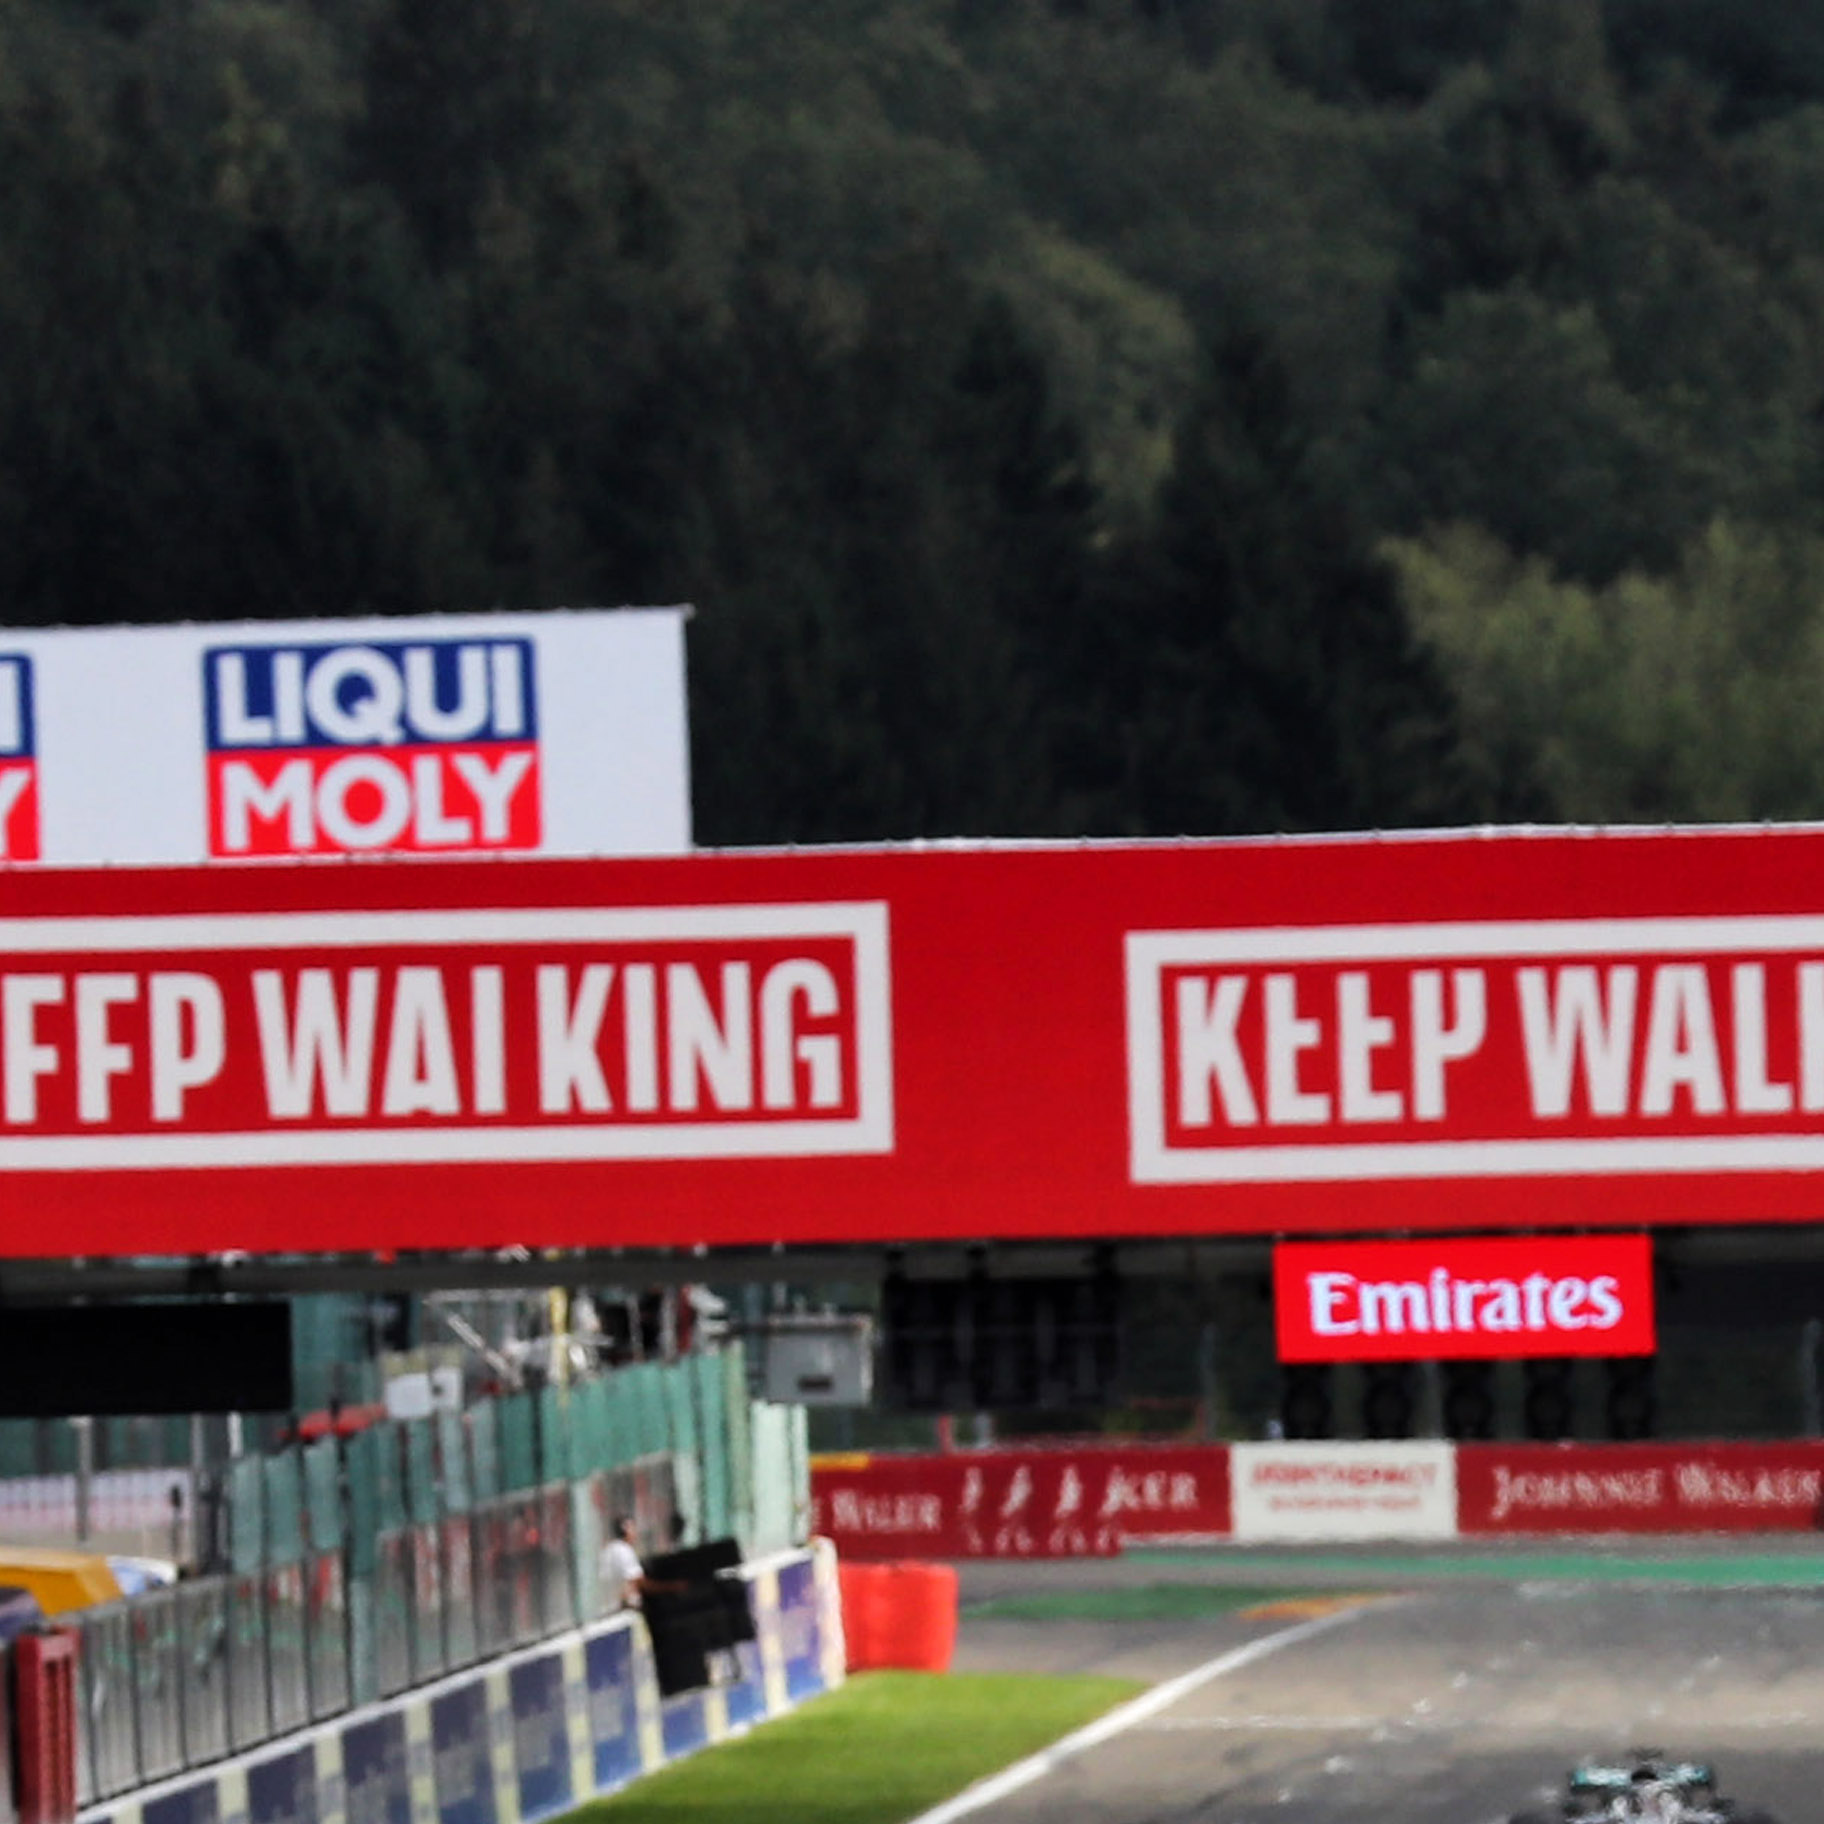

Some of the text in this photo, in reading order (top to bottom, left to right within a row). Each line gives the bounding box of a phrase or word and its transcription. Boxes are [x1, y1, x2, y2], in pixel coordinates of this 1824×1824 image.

[218, 643, 523, 746] LIQUI
[221, 750, 534, 852] MOLY
[1307, 1266, 1623, 1336] Emirates
